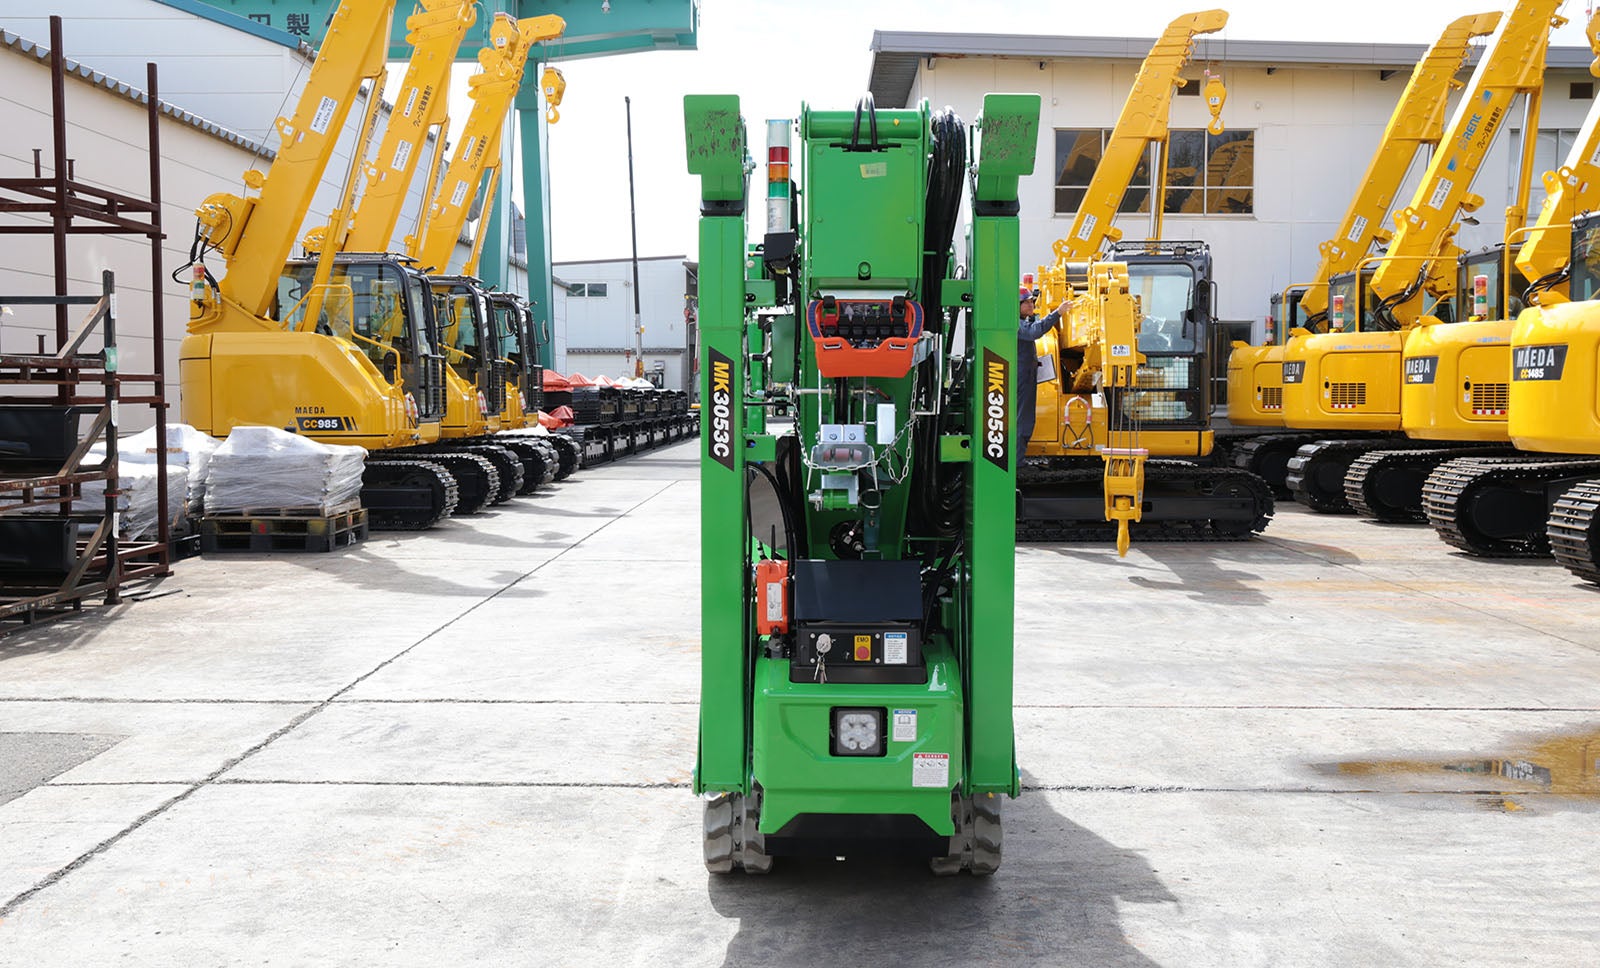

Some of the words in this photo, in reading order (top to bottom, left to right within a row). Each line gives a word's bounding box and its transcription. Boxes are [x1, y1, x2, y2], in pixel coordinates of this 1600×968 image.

[1517, 348, 1555, 368] MAEDA
[1405, 359, 1431, 374] MAEDA
[1520, 368, 1545, 379] CC1485
[295, 406, 326, 414] MAEDA
[713, 361, 730, 458] MK3053C
[987, 361, 1005, 459] MK3053C
[303, 419, 338, 429] CC985
